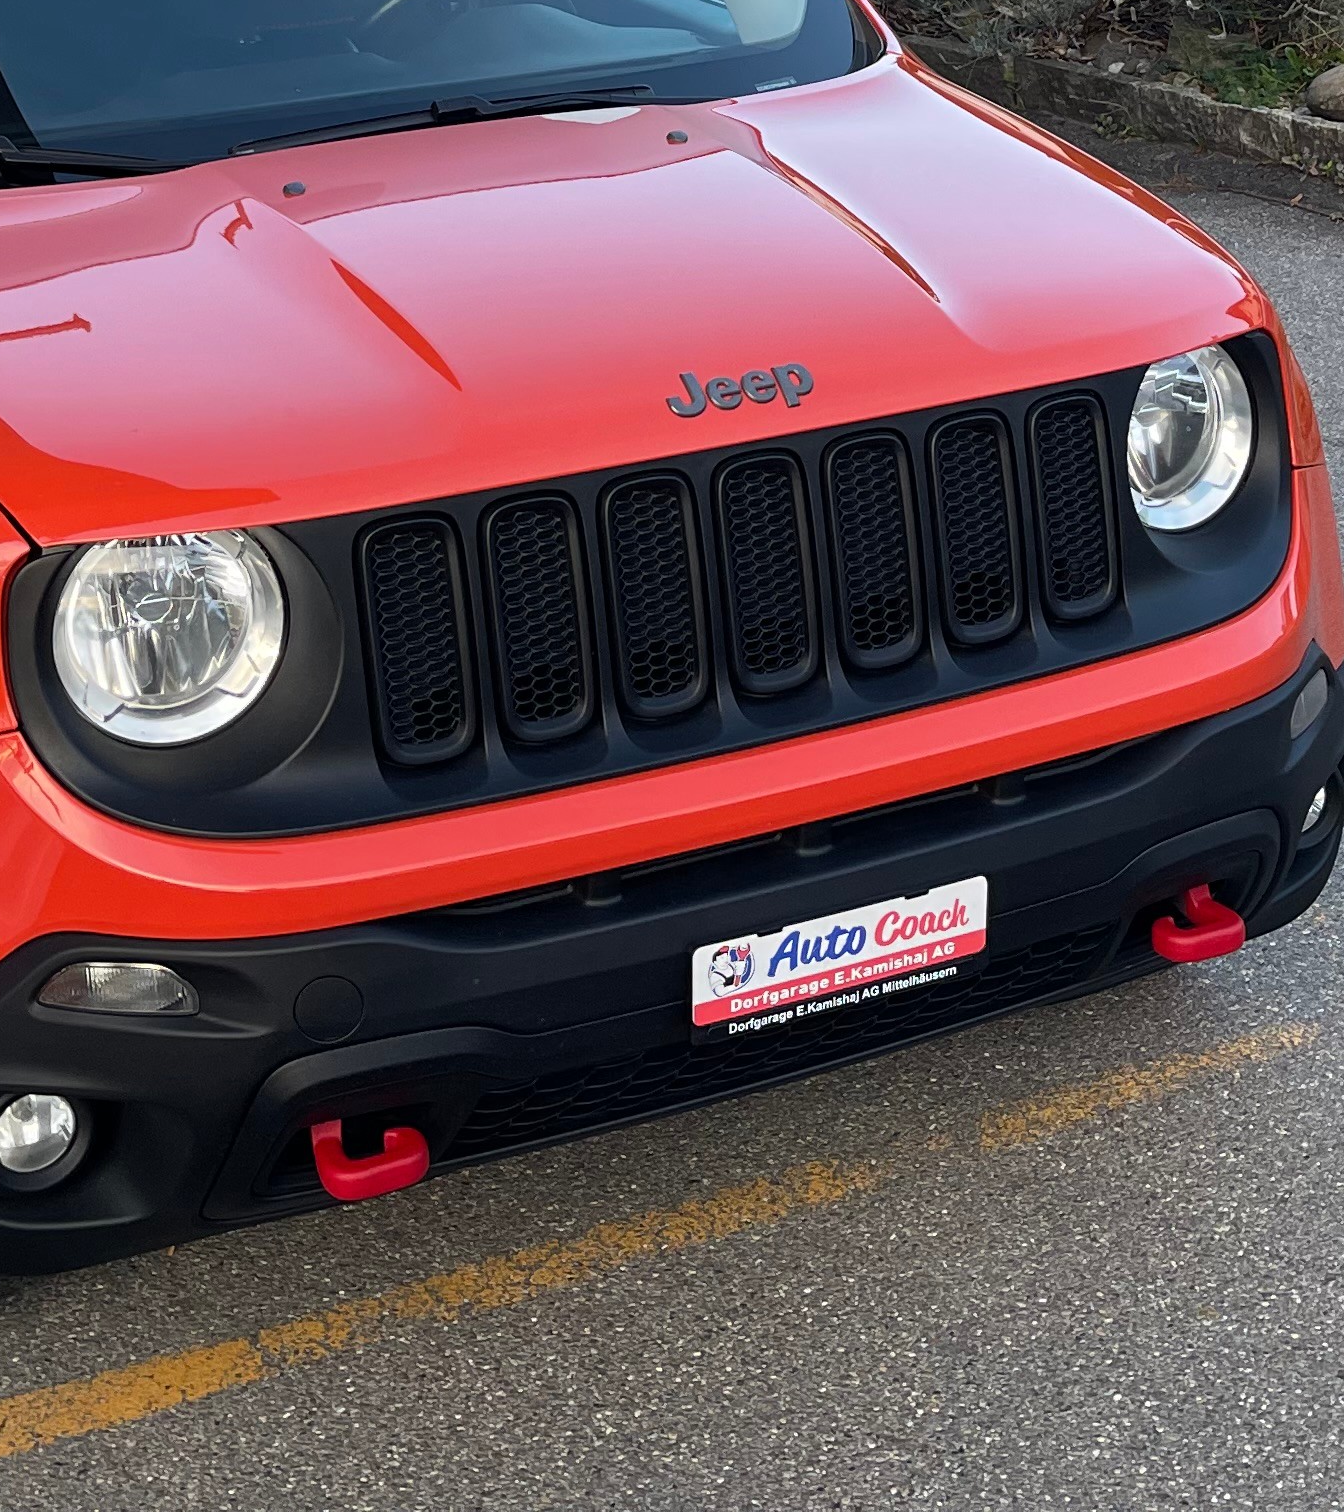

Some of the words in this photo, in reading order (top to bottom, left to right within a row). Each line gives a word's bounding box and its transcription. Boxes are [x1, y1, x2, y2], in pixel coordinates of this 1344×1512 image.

[666, 363, 814, 418] Jeep
[767, 925, 866, 977] Auto
[874, 898, 969, 947] Coach
[728, 1010, 793, 1034] Dorfgarage
[796, 990, 860, 1017] E.Kamishaj
[862, 985, 879, 999] AG
[882, 966, 957, 994] Mittelhäusern
[730, 977, 829, 1013] Dorfgarage
[834, 948, 928, 985] E.Kamishaj
[931, 941, 955, 959] AG
